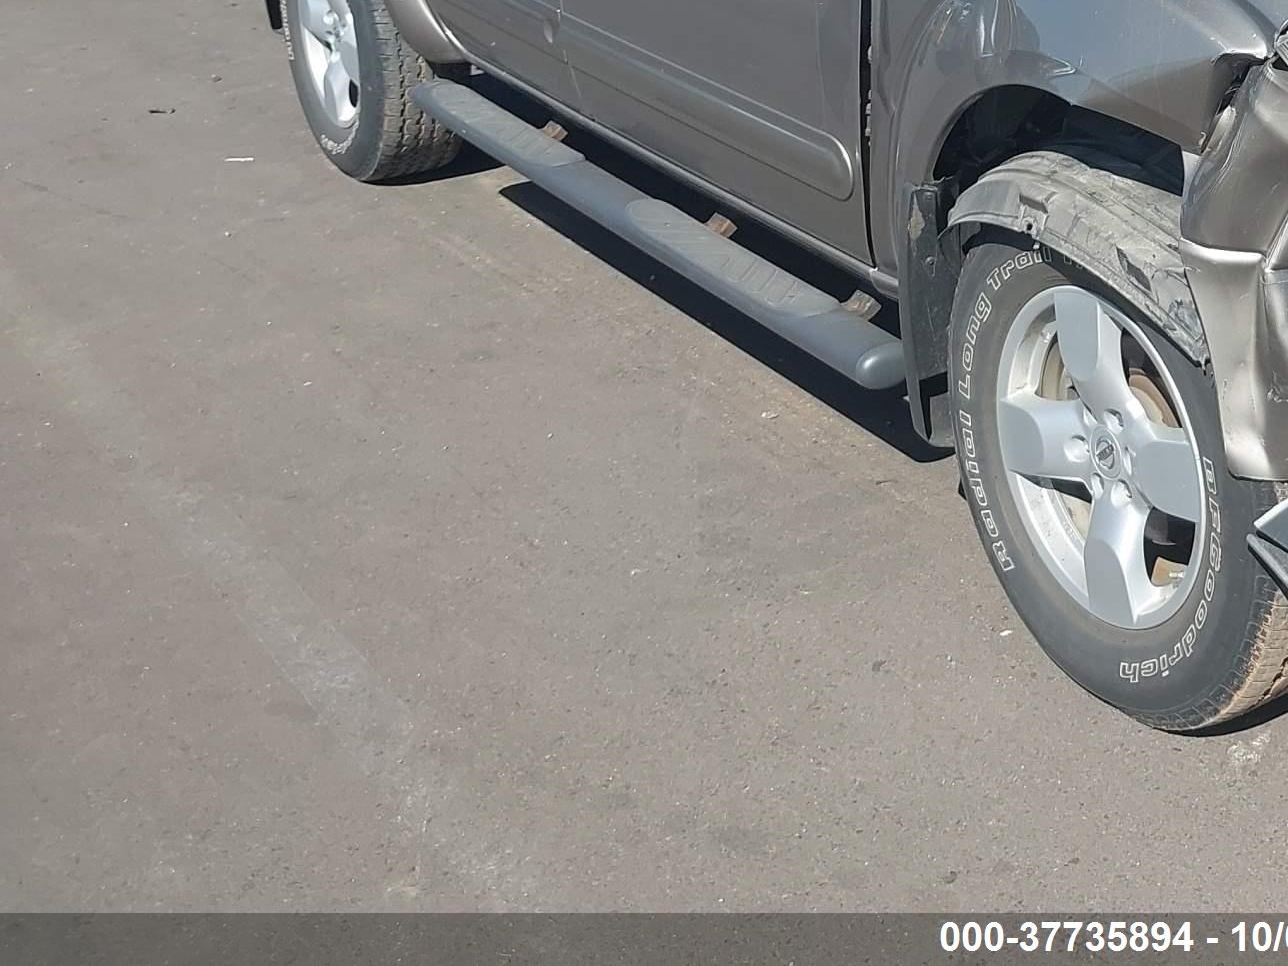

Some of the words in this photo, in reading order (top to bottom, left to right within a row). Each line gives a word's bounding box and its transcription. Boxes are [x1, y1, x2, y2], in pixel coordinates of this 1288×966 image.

[958, 292, 992, 400] Long
[959, 409, 1016, 572] Radial
[1119, 456, 1222, 684] BFGoodrich
